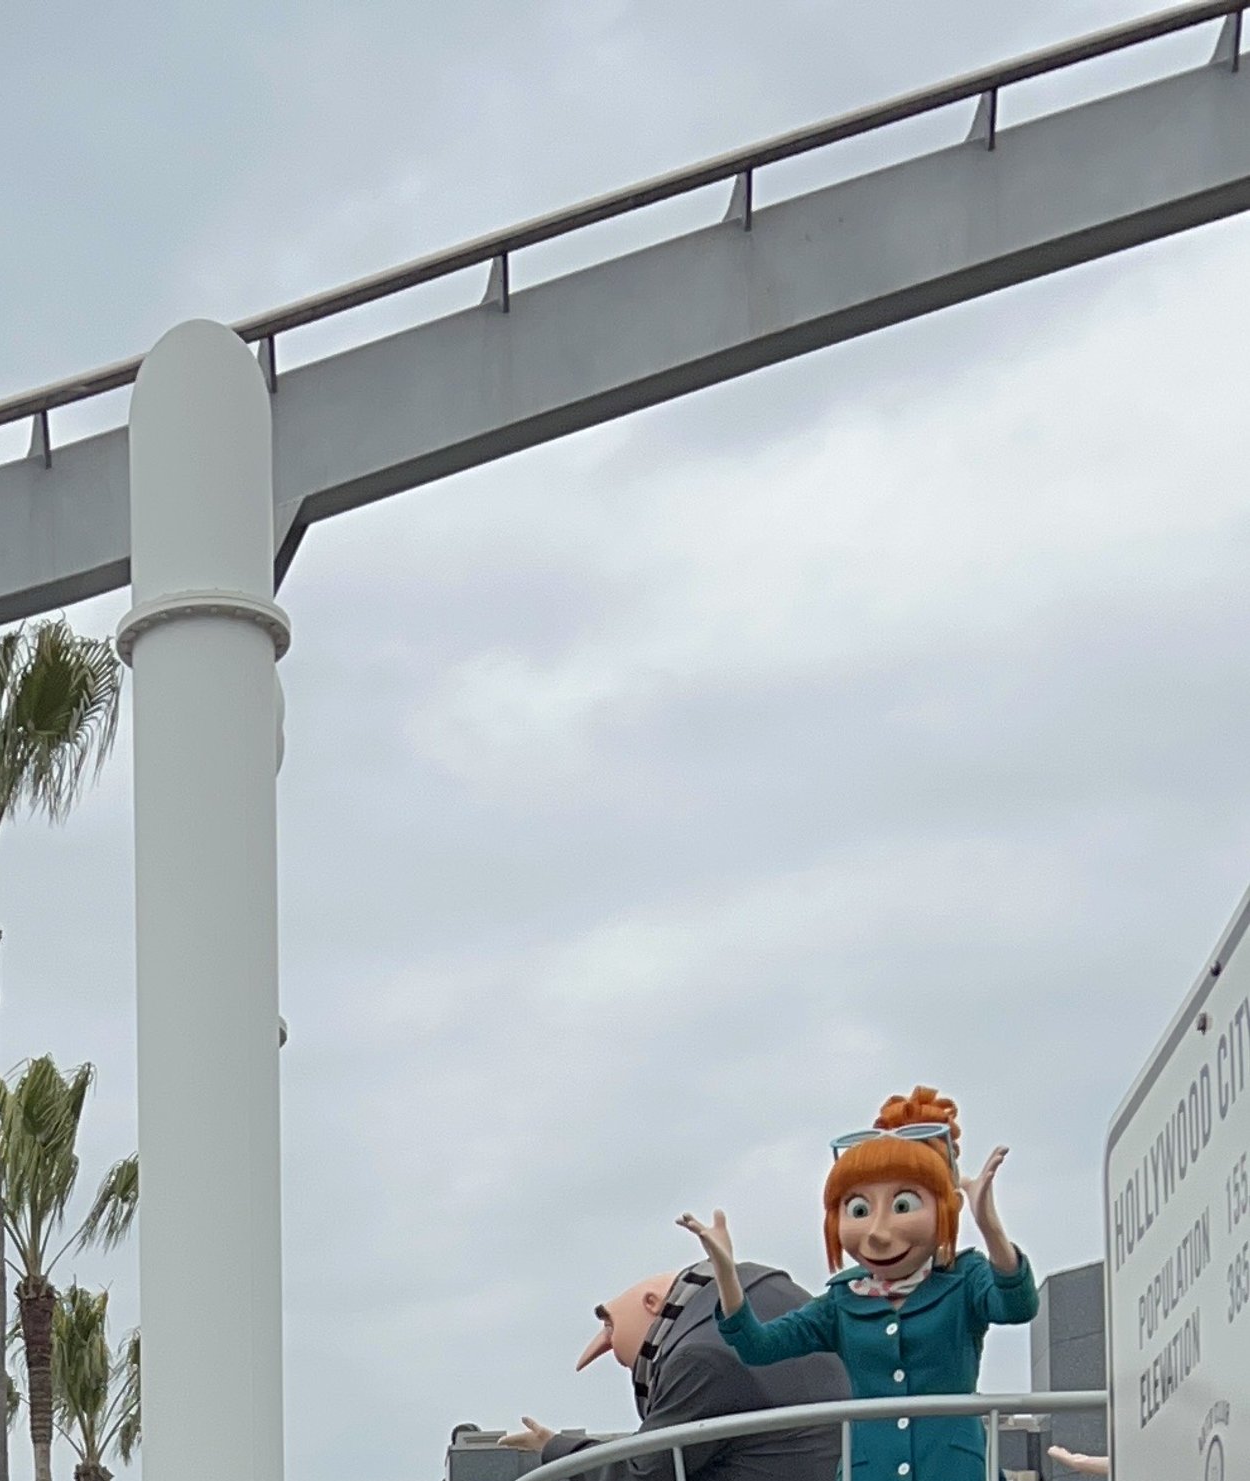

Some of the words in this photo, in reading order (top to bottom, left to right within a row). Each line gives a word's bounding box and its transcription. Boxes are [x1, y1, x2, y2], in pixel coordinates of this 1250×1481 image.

[1114, 1062, 1212, 1273] HOLLYWOOD
[1138, 1204, 1211, 1351] POPULATION
[1140, 1305, 1200, 1430] ELEVATION
